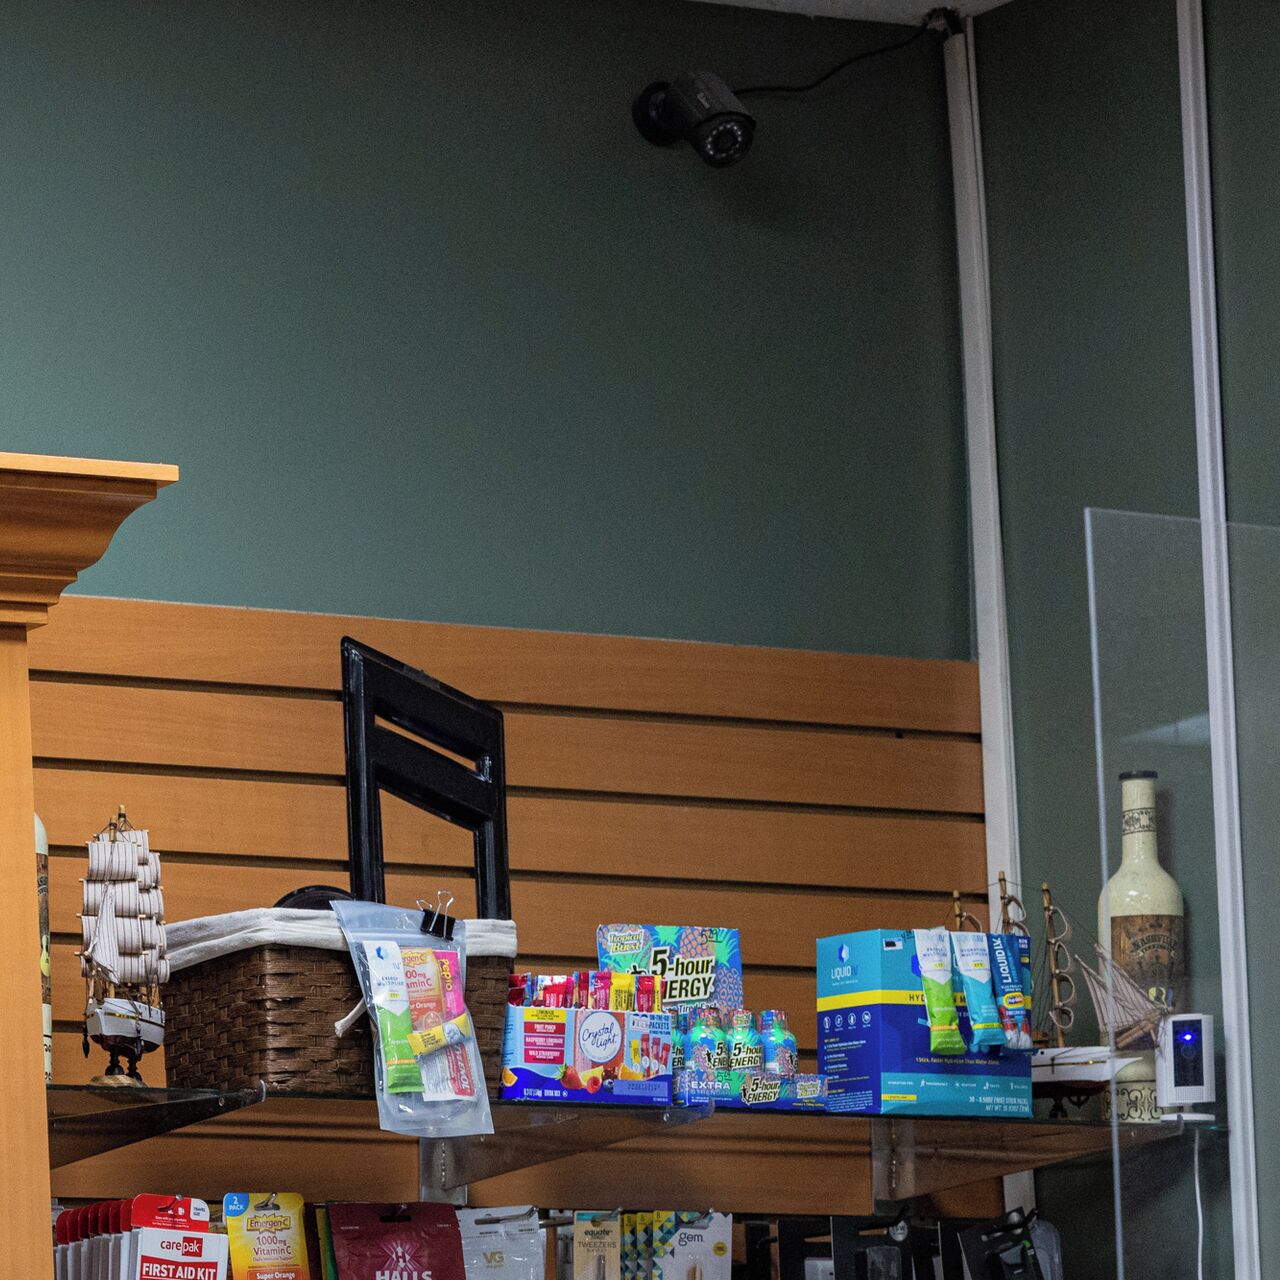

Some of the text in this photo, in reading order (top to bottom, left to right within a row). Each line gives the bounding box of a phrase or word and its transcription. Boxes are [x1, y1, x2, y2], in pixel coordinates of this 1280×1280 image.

[614, 941, 640, 952] Burst
[652, 948, 715, 976] 5-hour
[582, 1020, 614, 1043] Crystal
[678, 1233, 703, 1247] gem
[142, 1265, 215, 1280] FIRST AID KIT
